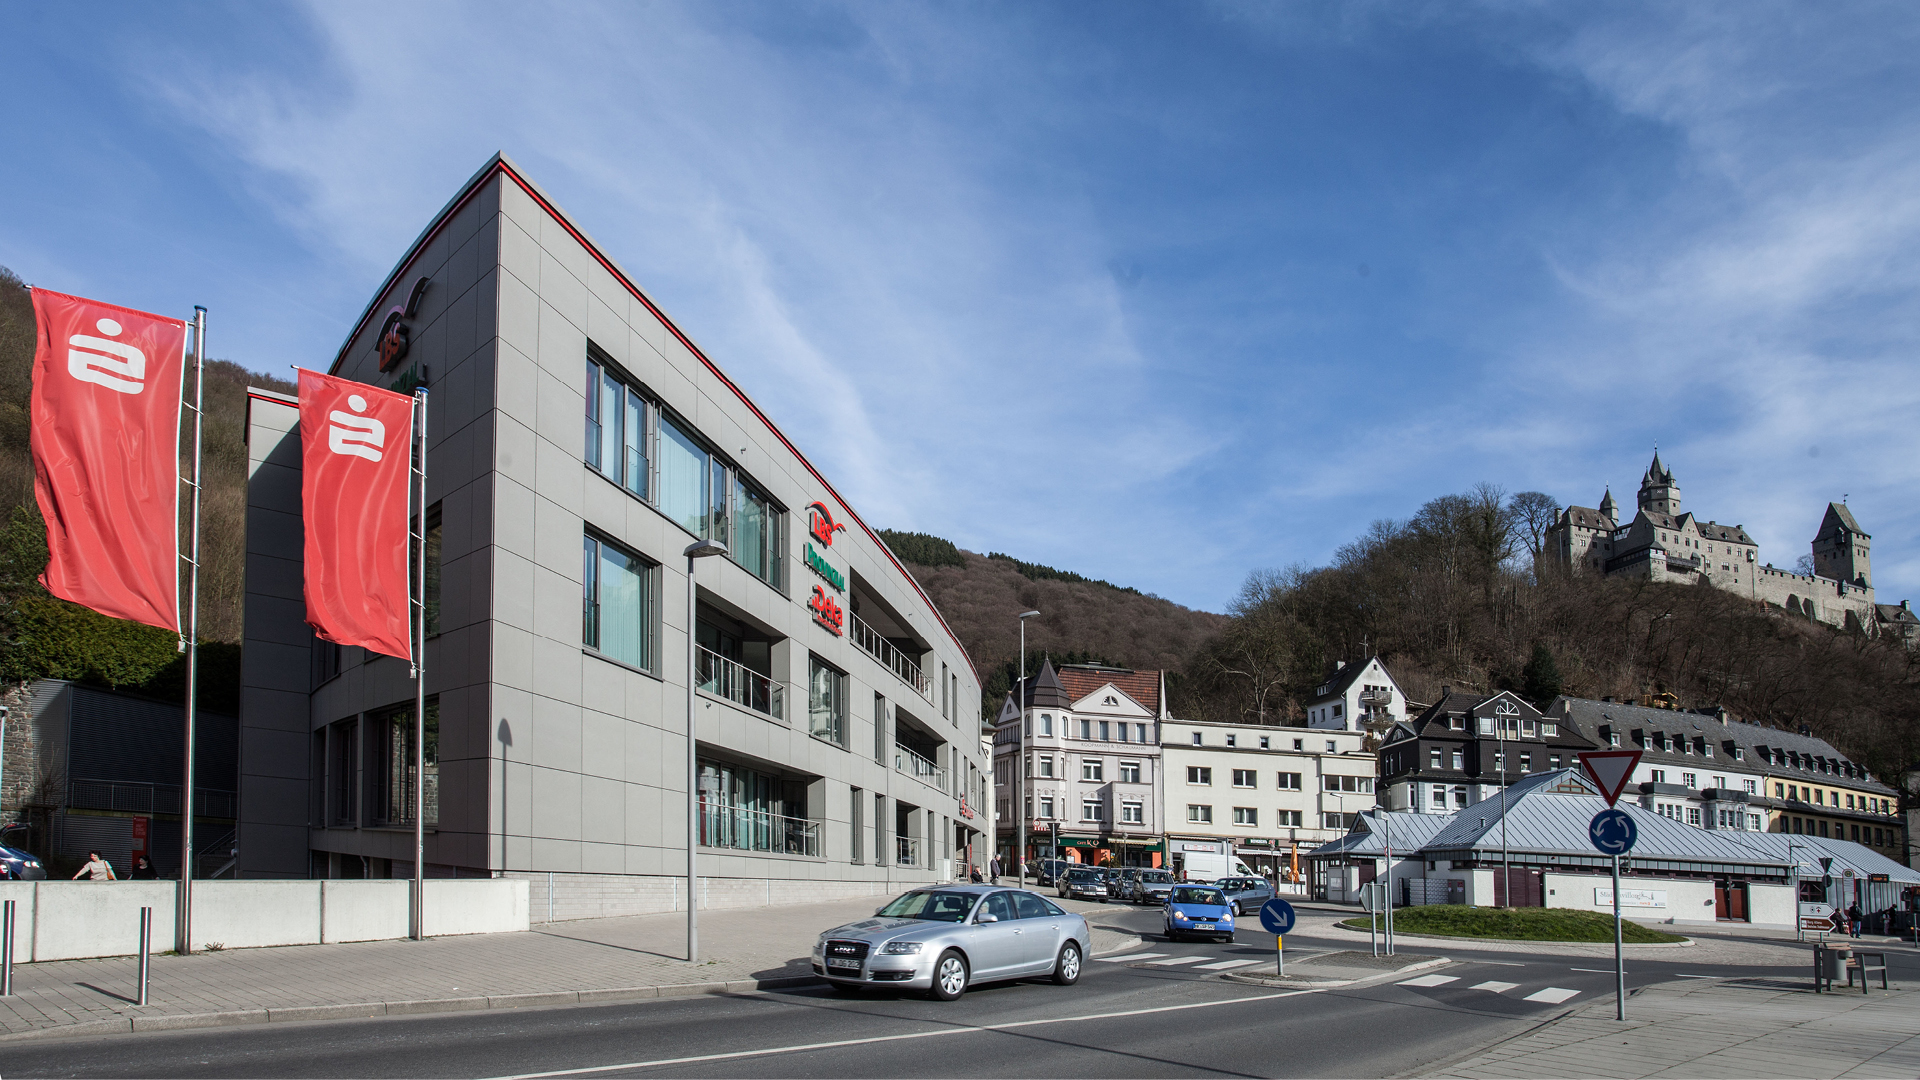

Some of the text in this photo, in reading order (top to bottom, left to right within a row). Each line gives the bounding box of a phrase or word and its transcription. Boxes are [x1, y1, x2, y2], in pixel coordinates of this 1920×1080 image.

[379, 322, 400, 372] LBS
[814, 511, 832, 546] LBS
[808, 542, 846, 592] PROVINZIAL
[816, 585, 843, 627] Deka
